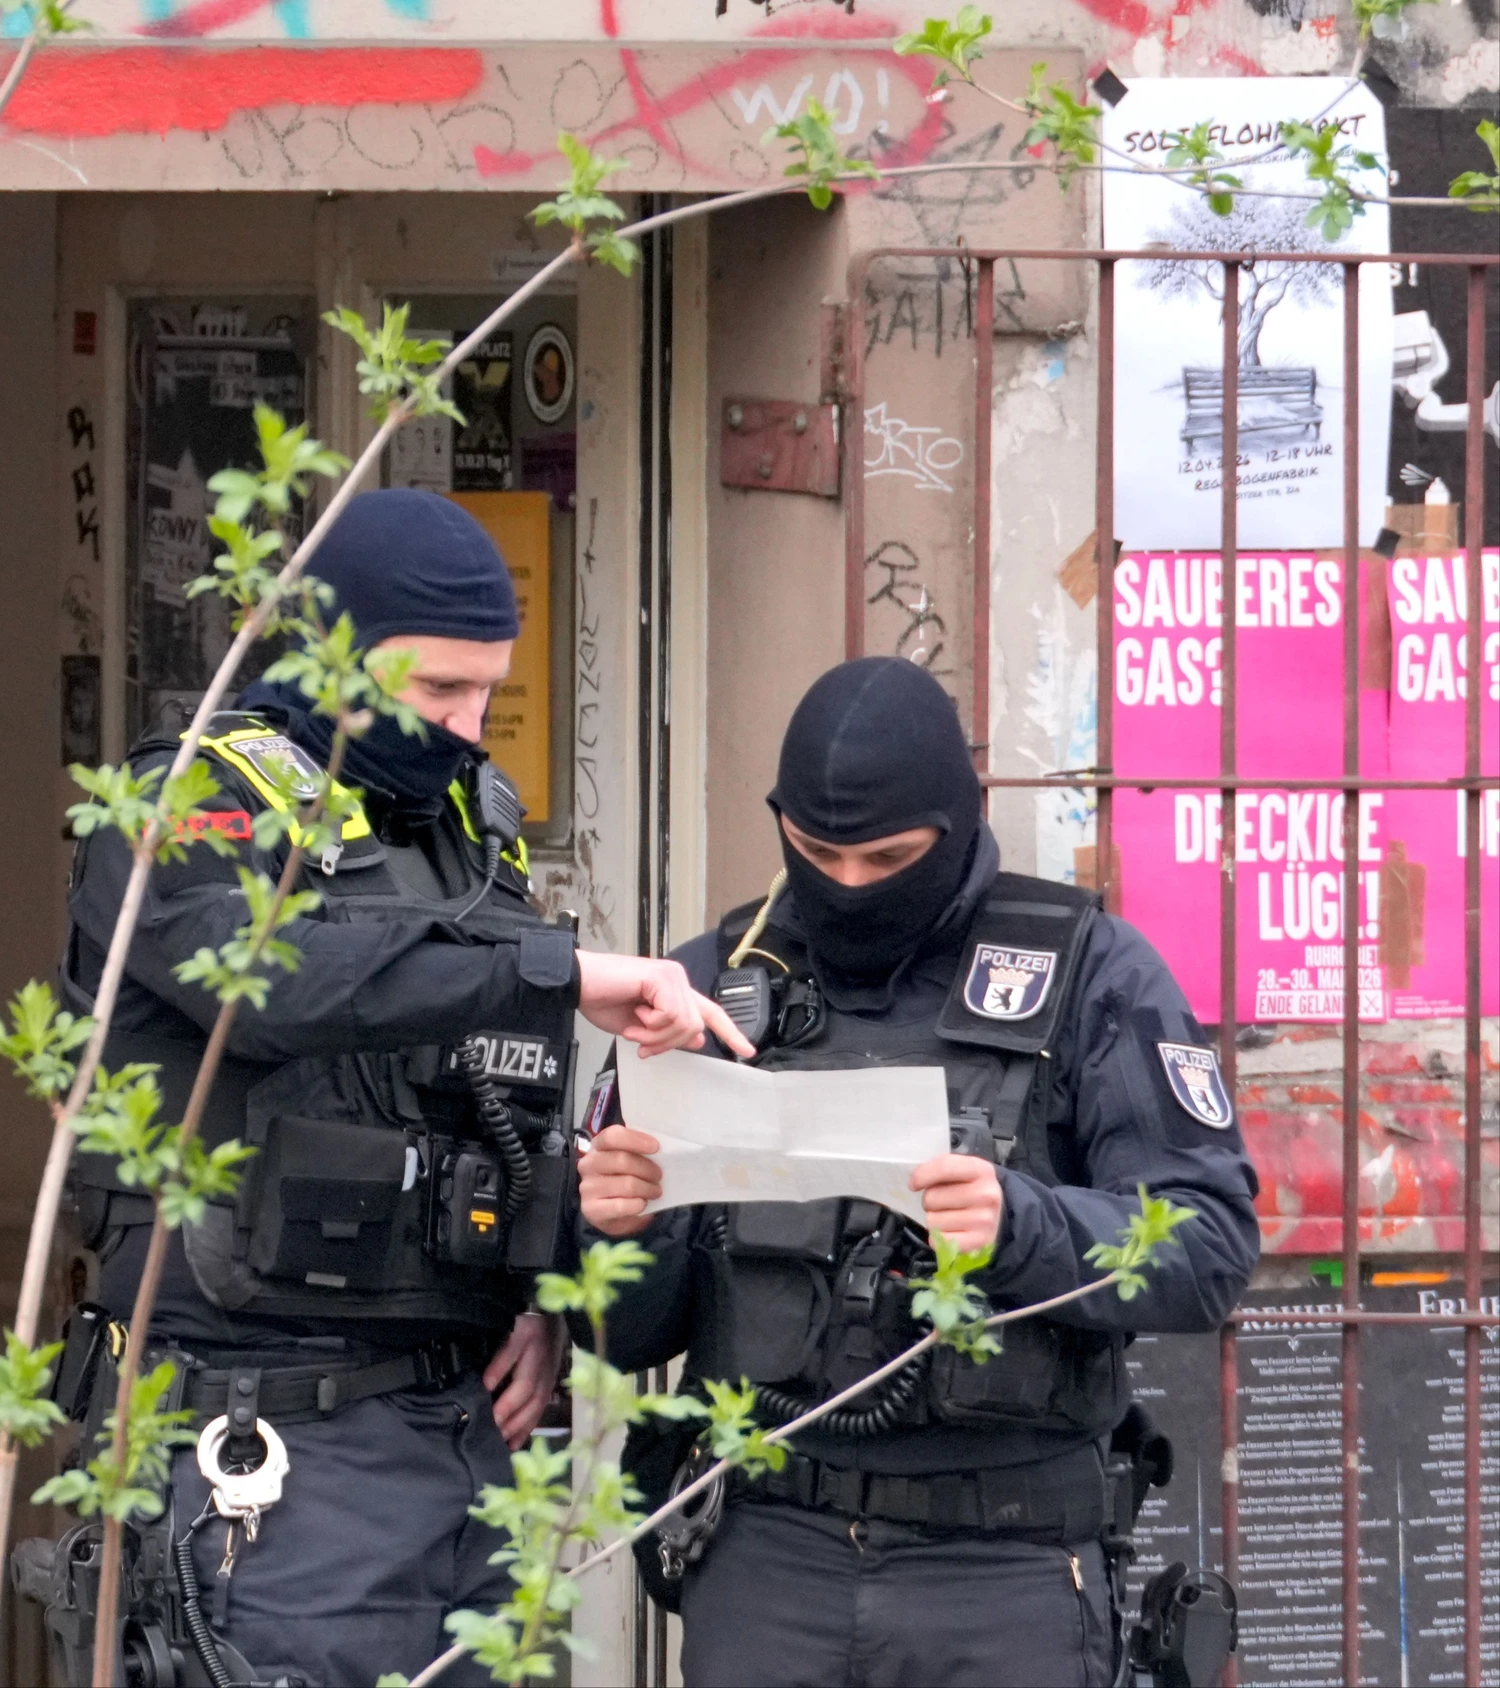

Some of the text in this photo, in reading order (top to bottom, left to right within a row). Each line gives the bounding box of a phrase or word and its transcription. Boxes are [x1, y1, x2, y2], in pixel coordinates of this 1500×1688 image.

[980, 949, 1052, 974] POLIZEI
[1258, 995, 1293, 1015] ENDE
[1165, 1048, 1215, 1072] POLIZEI
